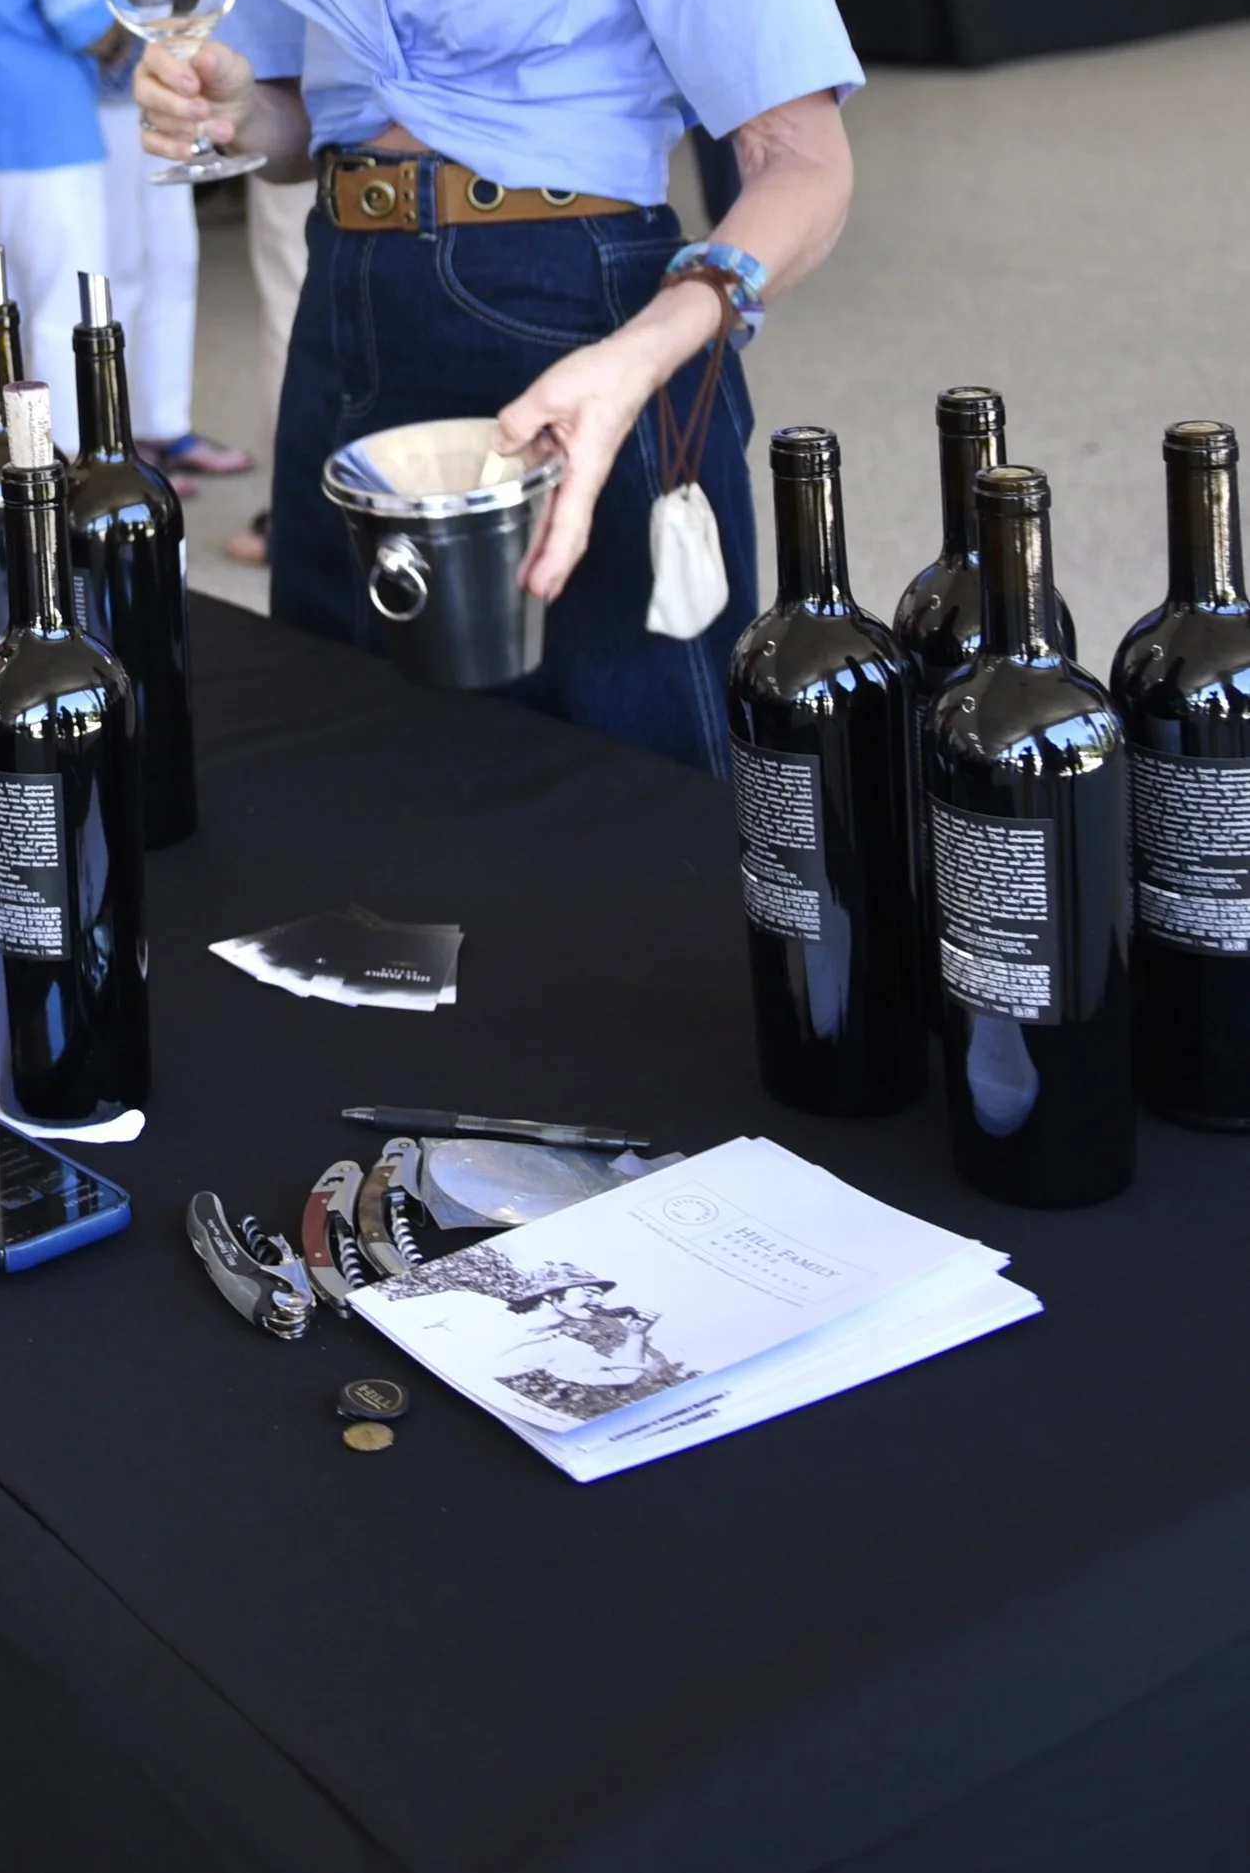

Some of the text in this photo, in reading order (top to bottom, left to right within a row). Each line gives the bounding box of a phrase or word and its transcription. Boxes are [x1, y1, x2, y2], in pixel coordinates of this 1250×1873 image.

[364, 970, 431, 983] HILL FAMILY
[724, 1233, 779, 1264] ESTATE
[734, 1226, 841, 1279] HILL FAMILY
[356, 1384, 392, 1409] HILL
